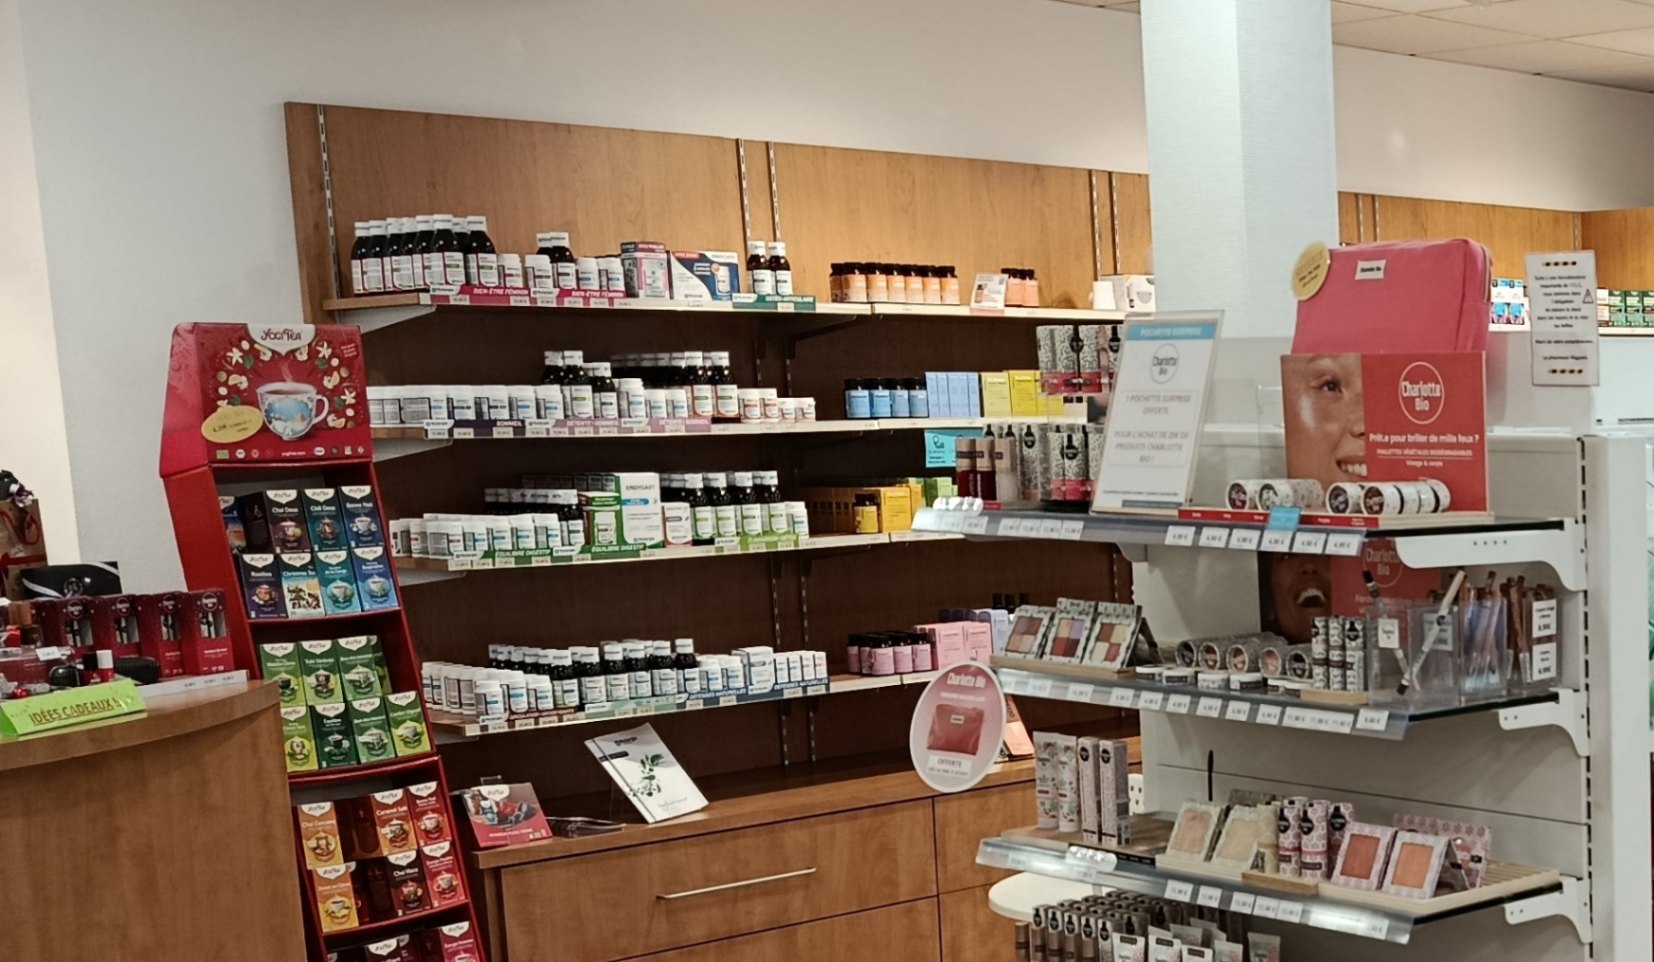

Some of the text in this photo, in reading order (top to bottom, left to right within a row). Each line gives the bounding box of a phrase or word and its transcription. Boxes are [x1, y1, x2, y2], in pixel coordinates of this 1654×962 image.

[1401, 381, 1441, 398] Charlotte
[1415, 398, 1430, 411] Bio
[1390, 434, 1406, 445] pour
[1429, 433, 1438, 443] de
[1439, 433, 1456, 443] mille
[61, 697, 114, 720] CADEAUX
